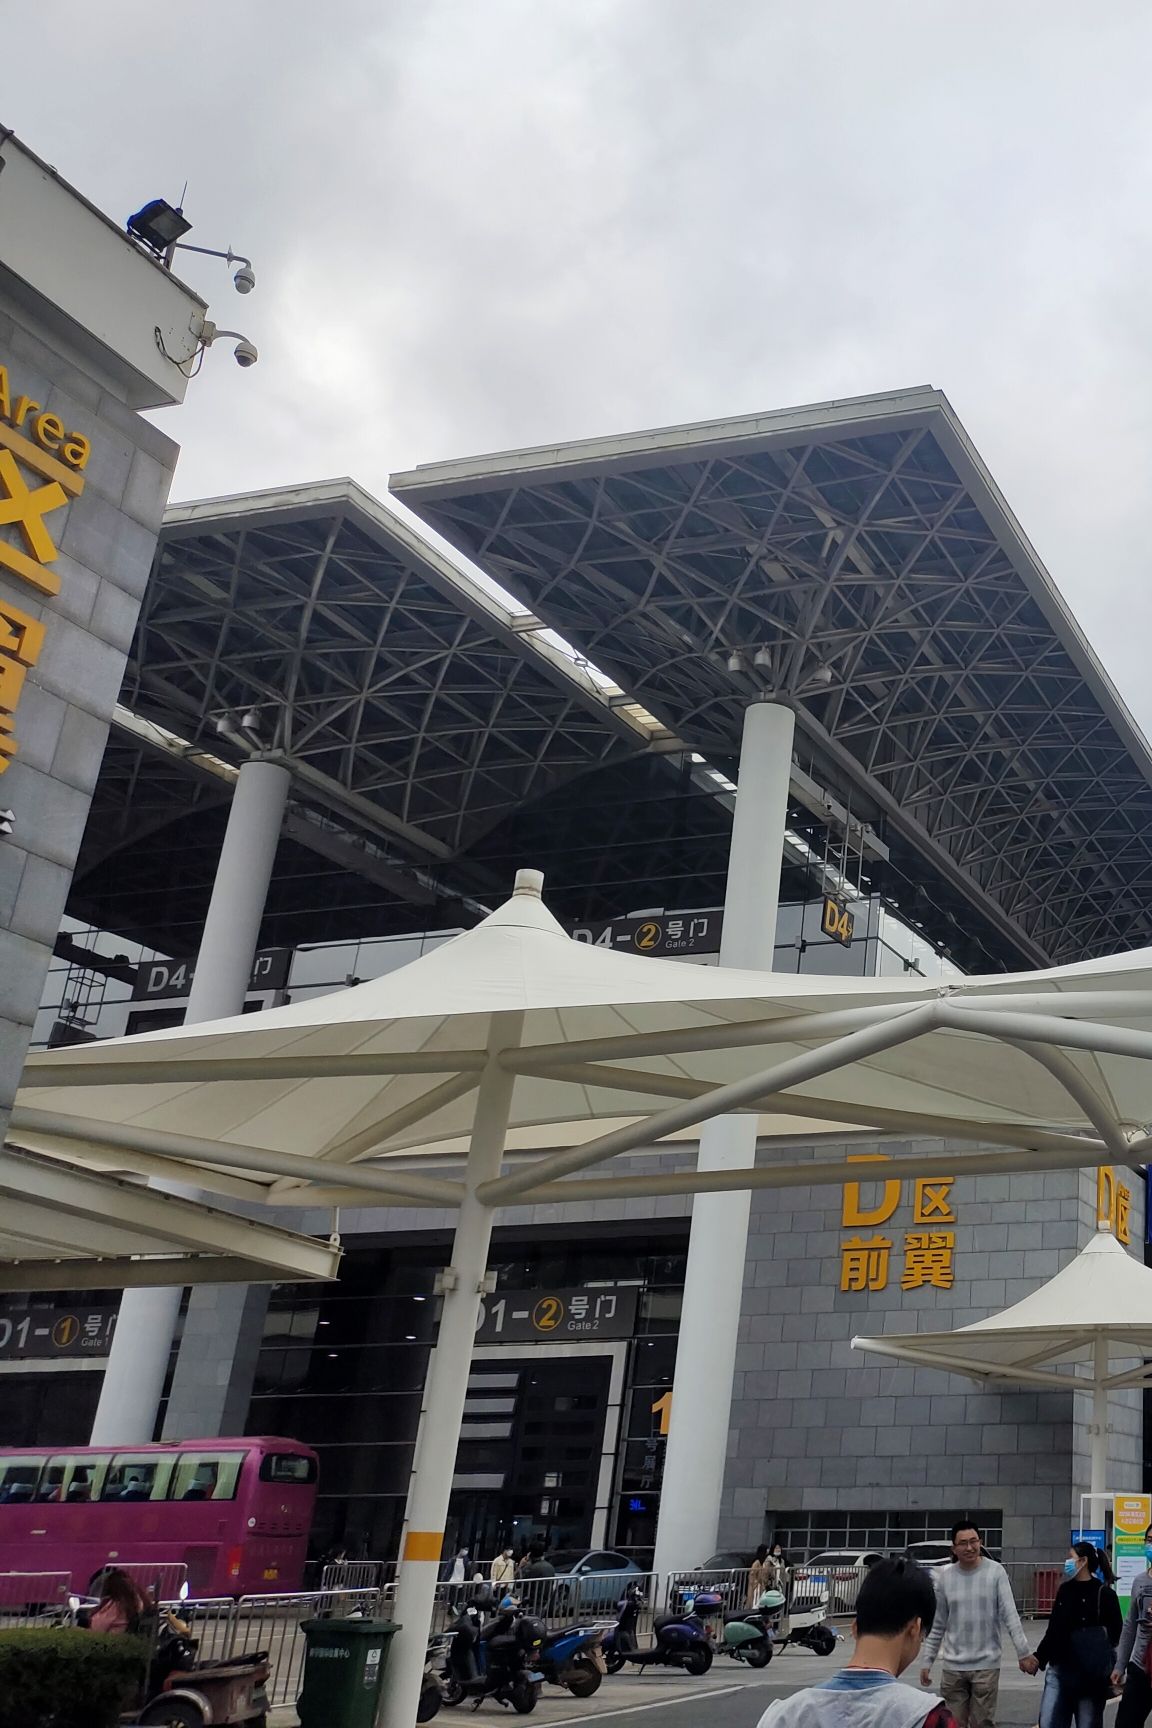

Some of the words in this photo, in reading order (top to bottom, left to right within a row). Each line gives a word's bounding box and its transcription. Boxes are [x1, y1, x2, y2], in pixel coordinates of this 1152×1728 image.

[826, 899, 849, 940] D4
[665, 940, 687, 949] Gate
[688, 938, 695, 947] 2
[841, 1231, 955, 1291] 前翼
[567, 1320, 591, 1331] Gate
[592, 1320, 599, 1330] 2
